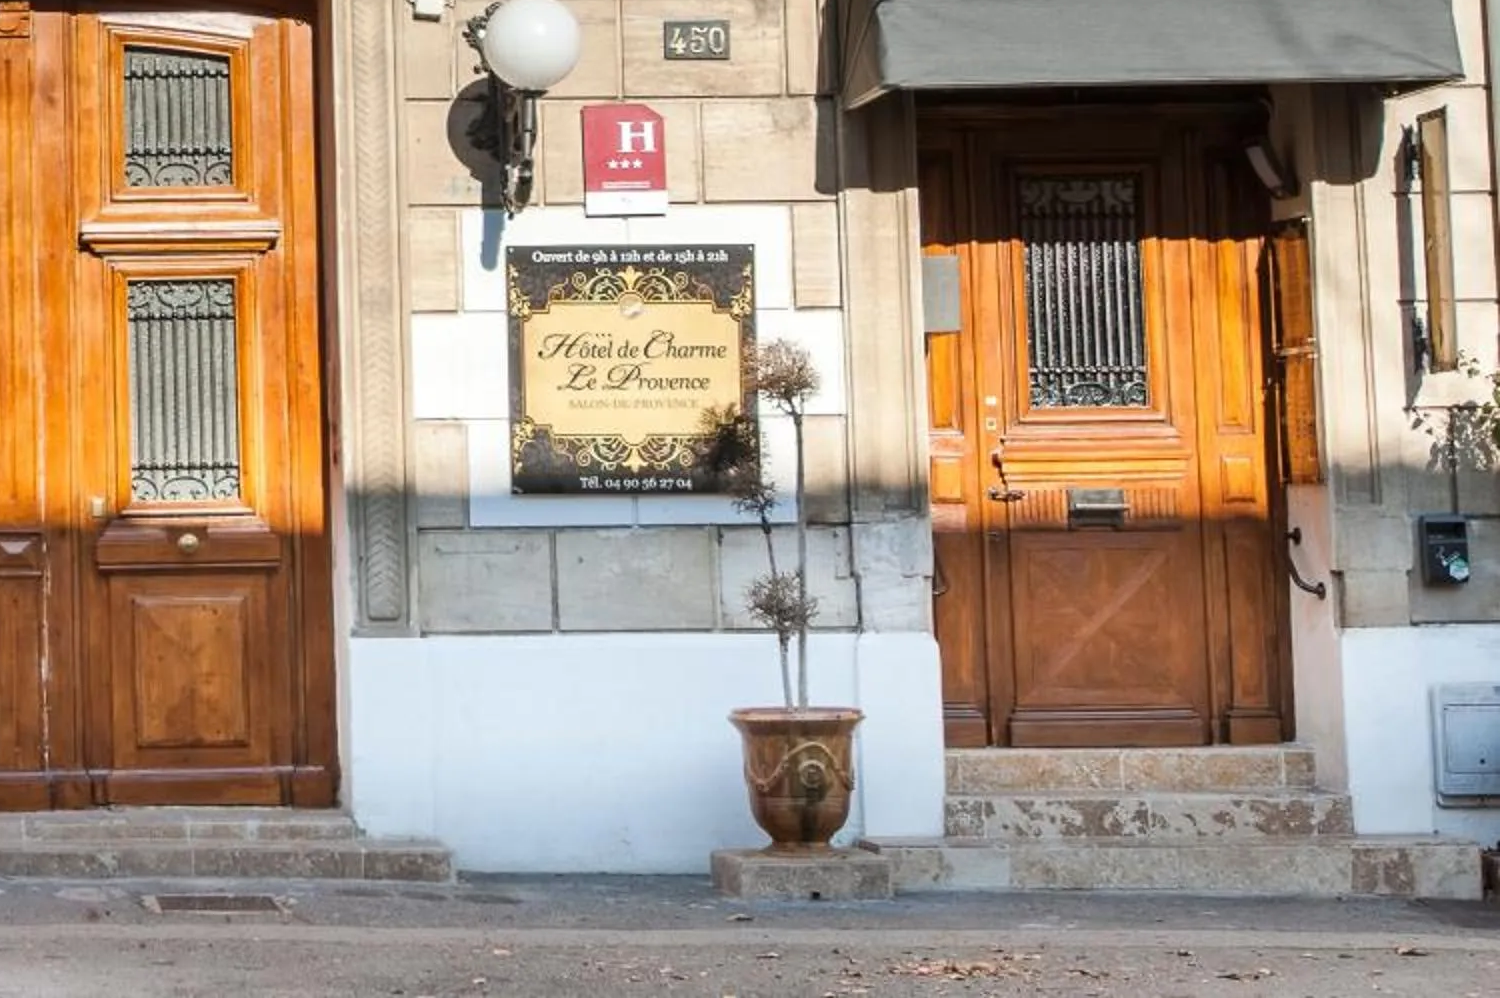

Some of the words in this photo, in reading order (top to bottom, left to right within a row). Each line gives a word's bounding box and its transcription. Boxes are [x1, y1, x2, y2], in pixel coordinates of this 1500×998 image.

[668, 26, 726, 55] 450
[617, 121, 657, 153] H
[531, 250, 573, 264] Ouvert
[575, 250, 590, 263] de
[592, 250, 609, 265] 9h
[620, 250, 641, 262] 12h
[643, 251, 656, 263] et
[657, 250, 673, 263] de
[537, 332, 614, 360] Hôtel
[616, 340, 638, 359] de
[643, 329, 727, 360] Charme
[556, 363, 597, 391] Le
[601, 362, 711, 391] Provence
[579, 476, 602, 489] Tél.
[604, 477, 621, 490] 04
[623, 477, 640, 490] 90
[676, 477, 693, 490] 04
